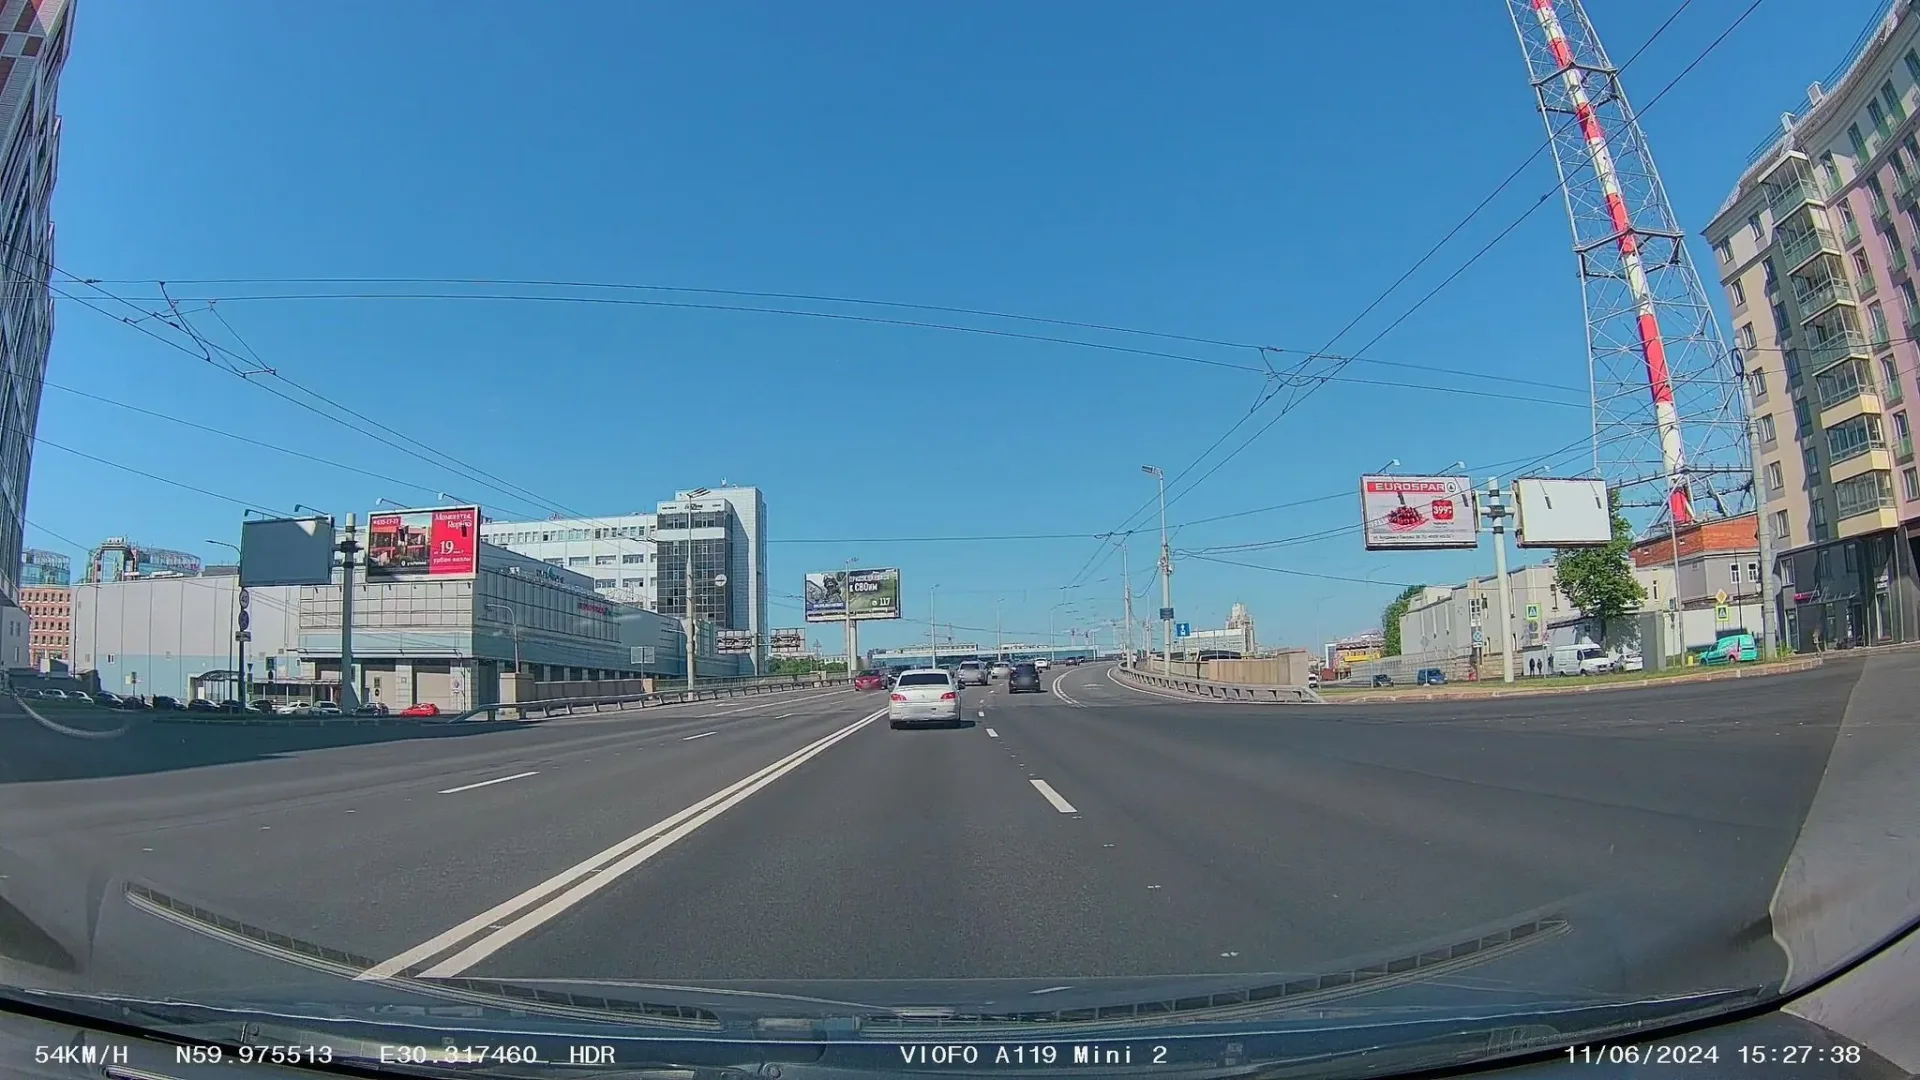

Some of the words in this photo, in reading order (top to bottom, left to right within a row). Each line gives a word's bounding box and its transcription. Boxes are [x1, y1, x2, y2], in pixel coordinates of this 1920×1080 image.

[1375, 483, 1445, 491] EUROSPAR
[440, 540, 454, 555] 19
[879, 597, 891, 606] 117
